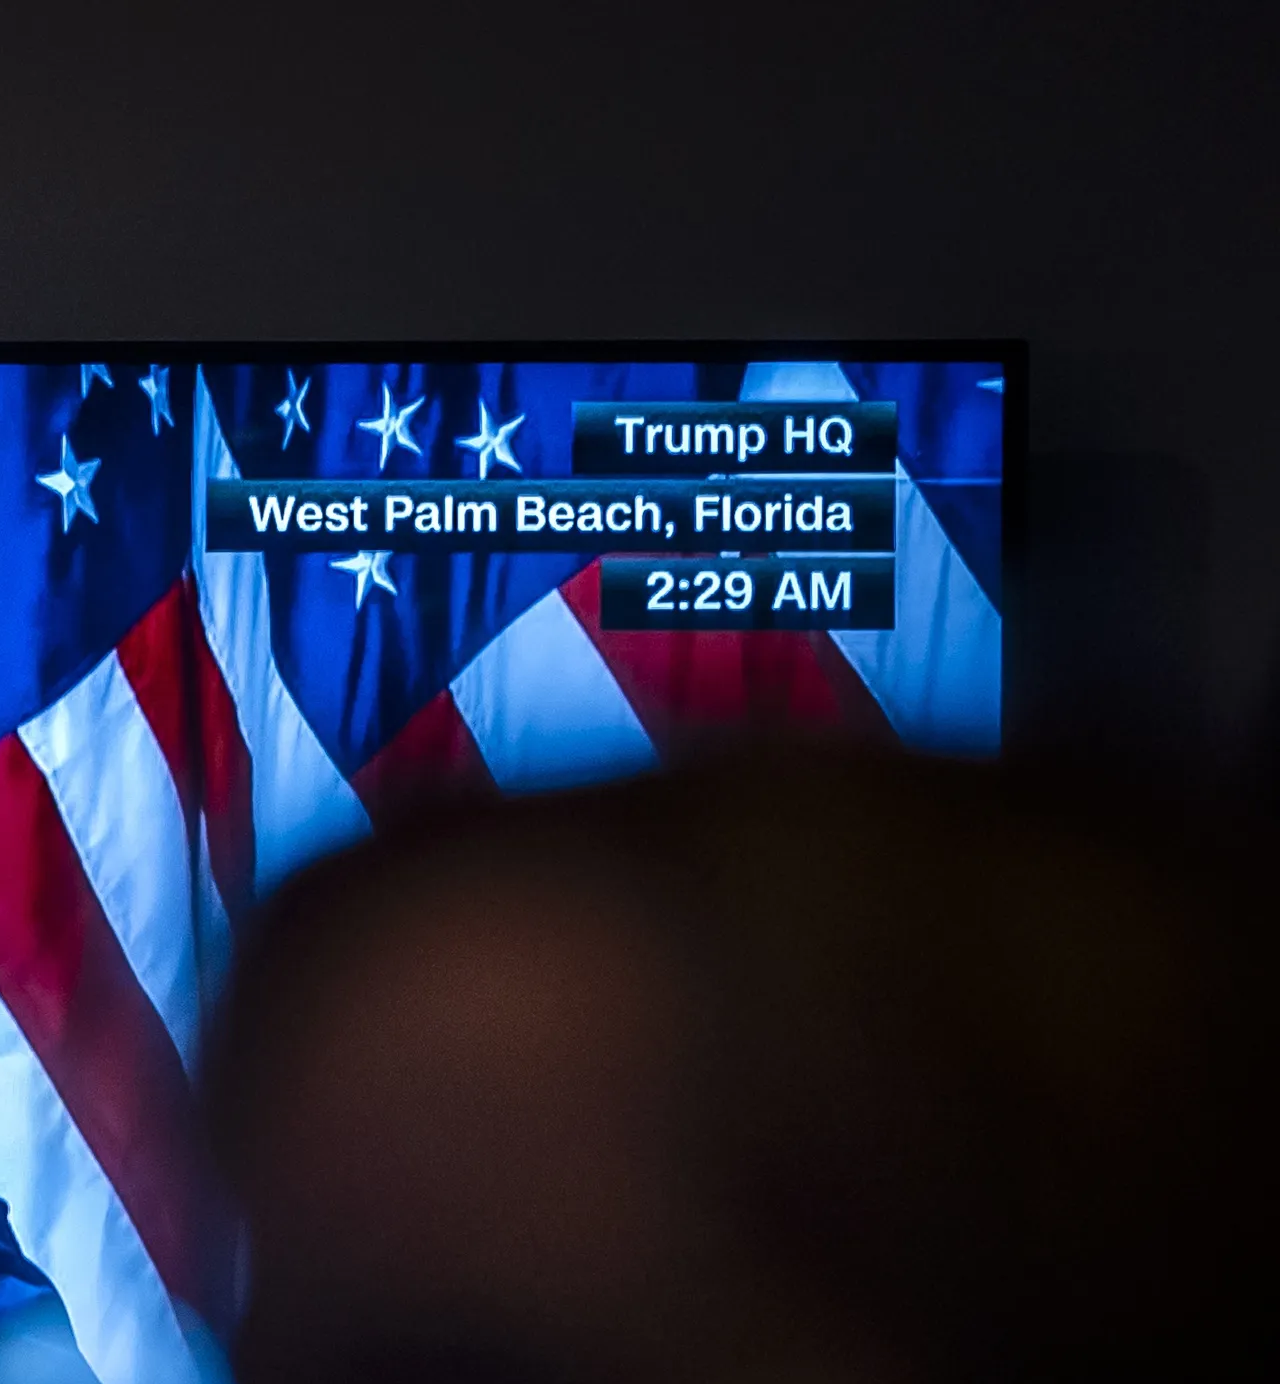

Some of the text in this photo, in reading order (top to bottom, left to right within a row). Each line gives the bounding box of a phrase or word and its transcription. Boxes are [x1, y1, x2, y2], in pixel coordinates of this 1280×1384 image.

[614, 416, 853, 463] Trump HQ
[248, 493, 852, 539] West Palm Beach, Florida
[646, 570, 852, 611] 2:29 AM
